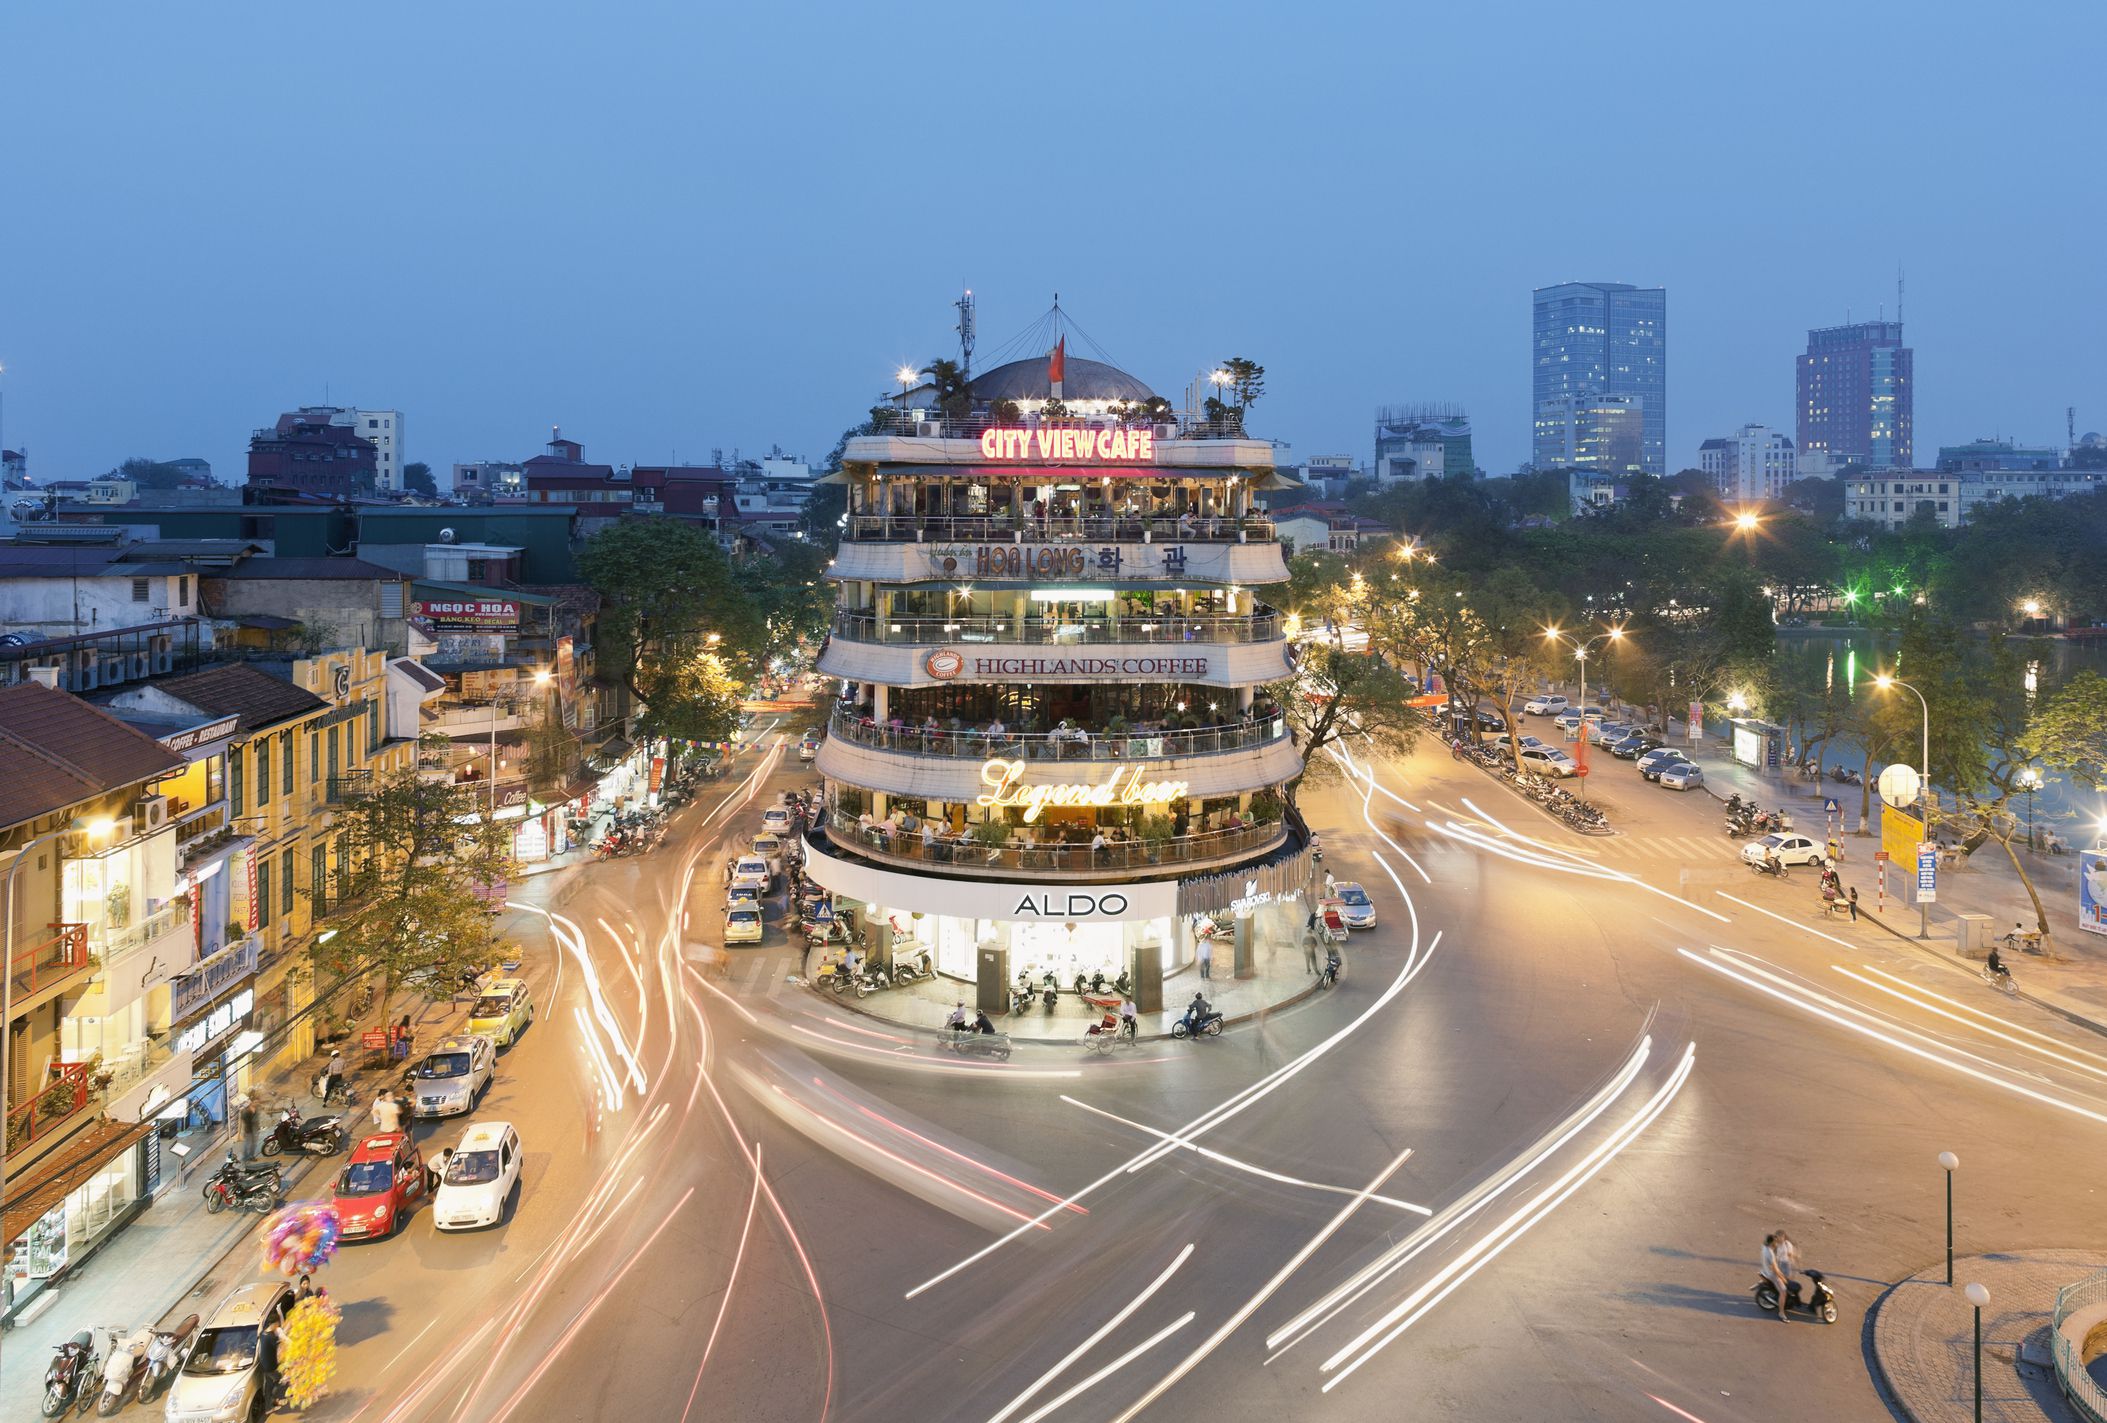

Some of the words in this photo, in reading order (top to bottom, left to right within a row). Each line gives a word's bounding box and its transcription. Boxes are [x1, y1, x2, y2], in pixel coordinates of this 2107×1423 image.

[981, 428, 1033, 459] CITY
[1037, 429, 1096, 459] VIEW
[1097, 430, 1153, 459] CAFE
[977, 546, 1020, 577] HOA
[1026, 547, 1085, 575] LONG
[1098, 546, 1124, 573] 화
[1162, 545, 1188, 573] 관
[430, 603, 475, 614] NGỌC
[481, 604, 514, 613] HOA
[930, 651, 960, 663] HIGHLANDS
[975, 658, 1116, 675] HIGHLANDS
[1122, 658, 1207, 674] COFFEE
[936, 670, 956, 678] COFFEE
[170, 733, 195, 752] COFFEE
[198, 719, 238, 743] RESTAURANT
[504, 790, 527, 805] Coffee
[976, 758, 1125, 823] Legend
[1121, 765, 1189, 804] beer
[1014, 894, 1128, 916] ALDO
